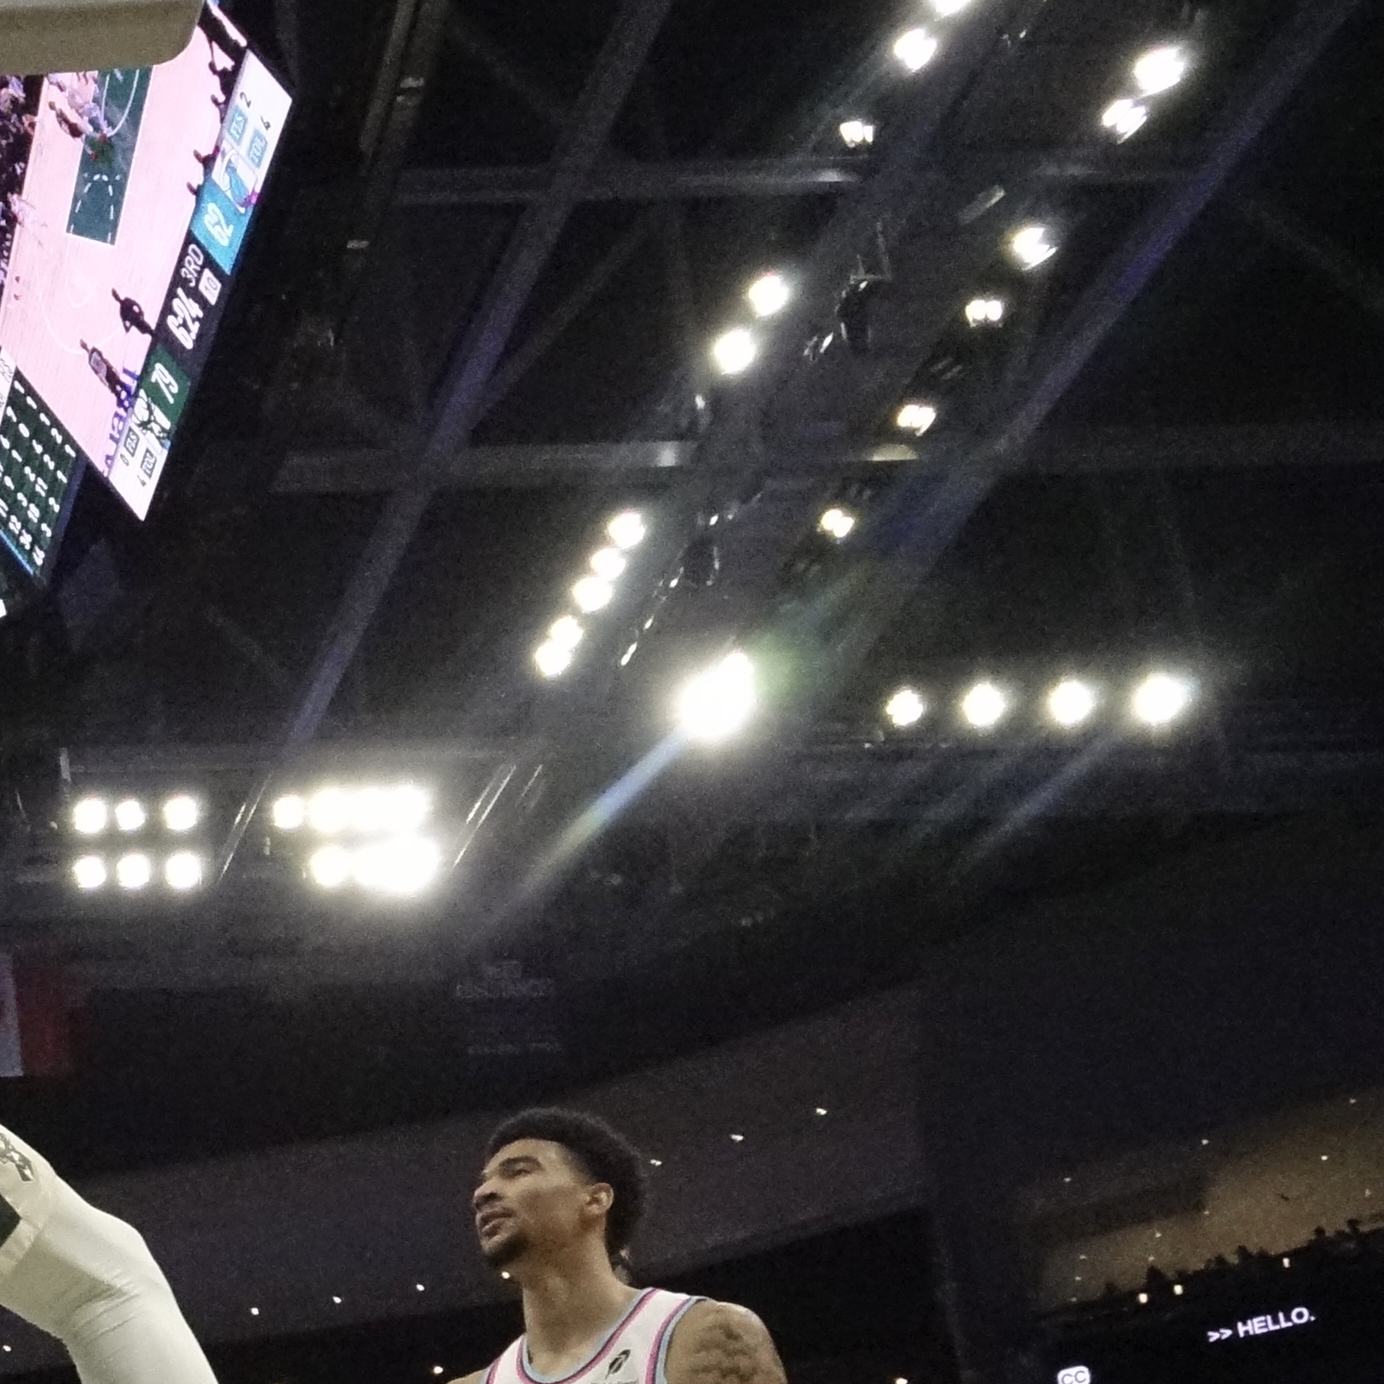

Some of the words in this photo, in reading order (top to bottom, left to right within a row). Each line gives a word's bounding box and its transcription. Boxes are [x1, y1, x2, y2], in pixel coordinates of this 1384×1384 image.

[204, 202, 233, 246] 62
[180, 243, 204, 287] 3RD
[151, 363, 179, 405] 79
[1237, 1307, 1315, 1338] HELLO.
